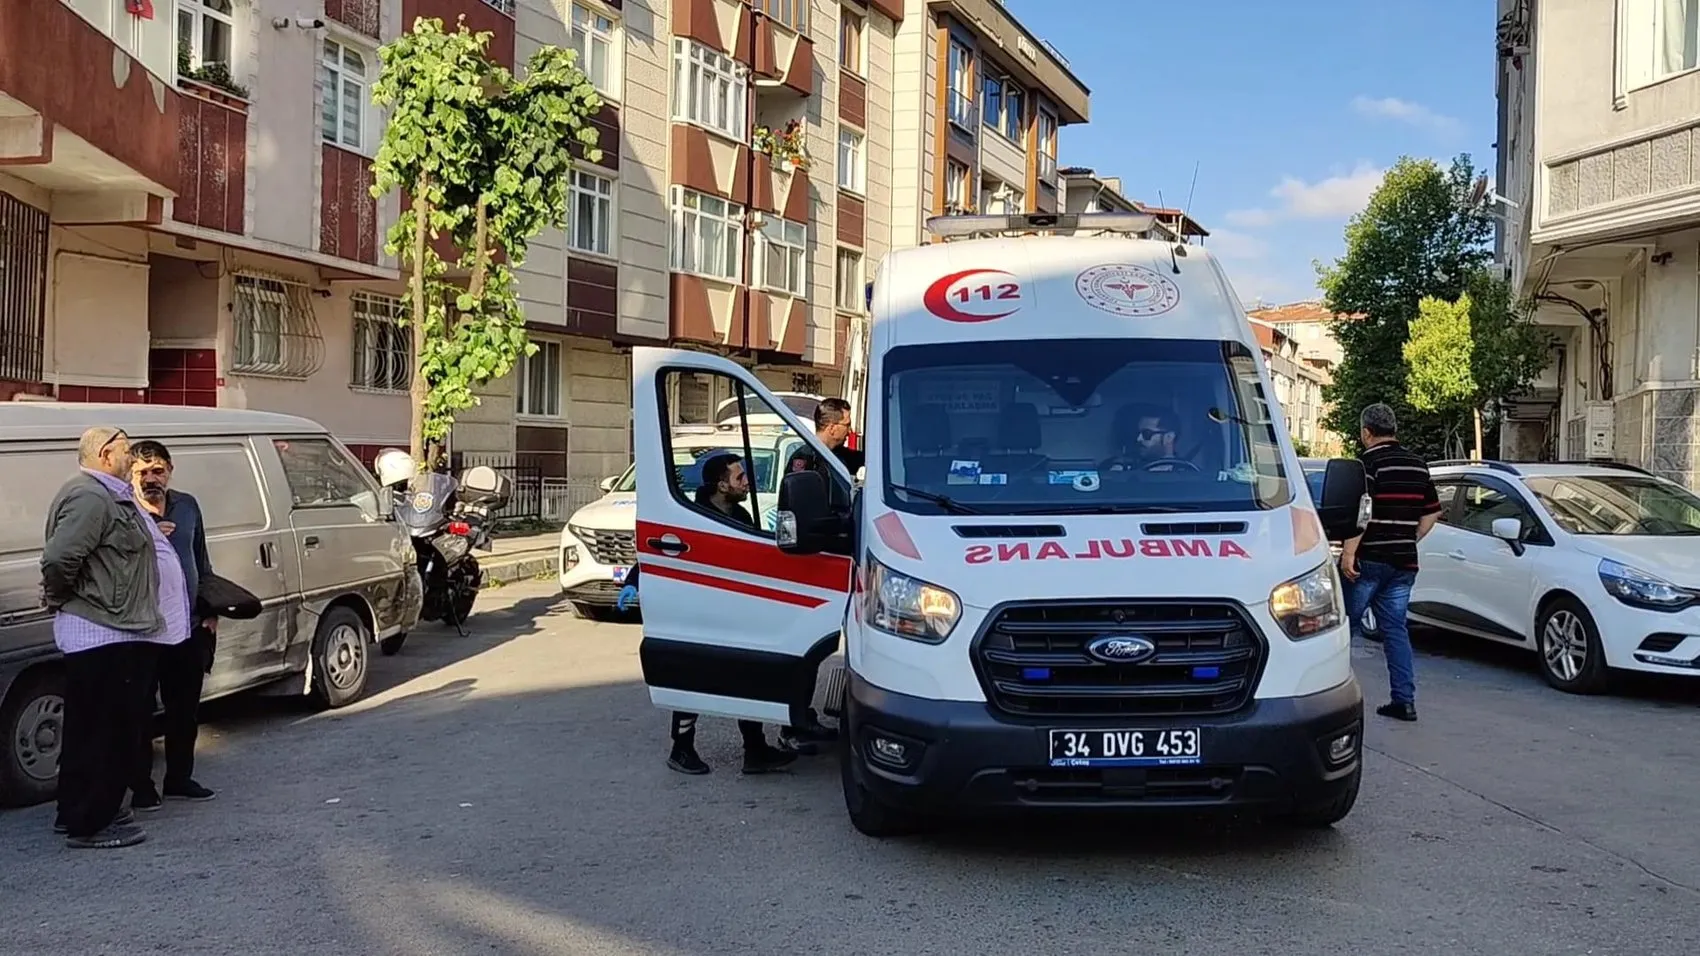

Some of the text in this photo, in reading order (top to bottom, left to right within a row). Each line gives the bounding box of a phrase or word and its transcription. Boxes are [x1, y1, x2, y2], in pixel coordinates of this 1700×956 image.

[952, 283, 1020, 303] 112
[1104, 640, 1140, 657] Ford
[1063, 730, 1197, 757] 34 DVG 453
